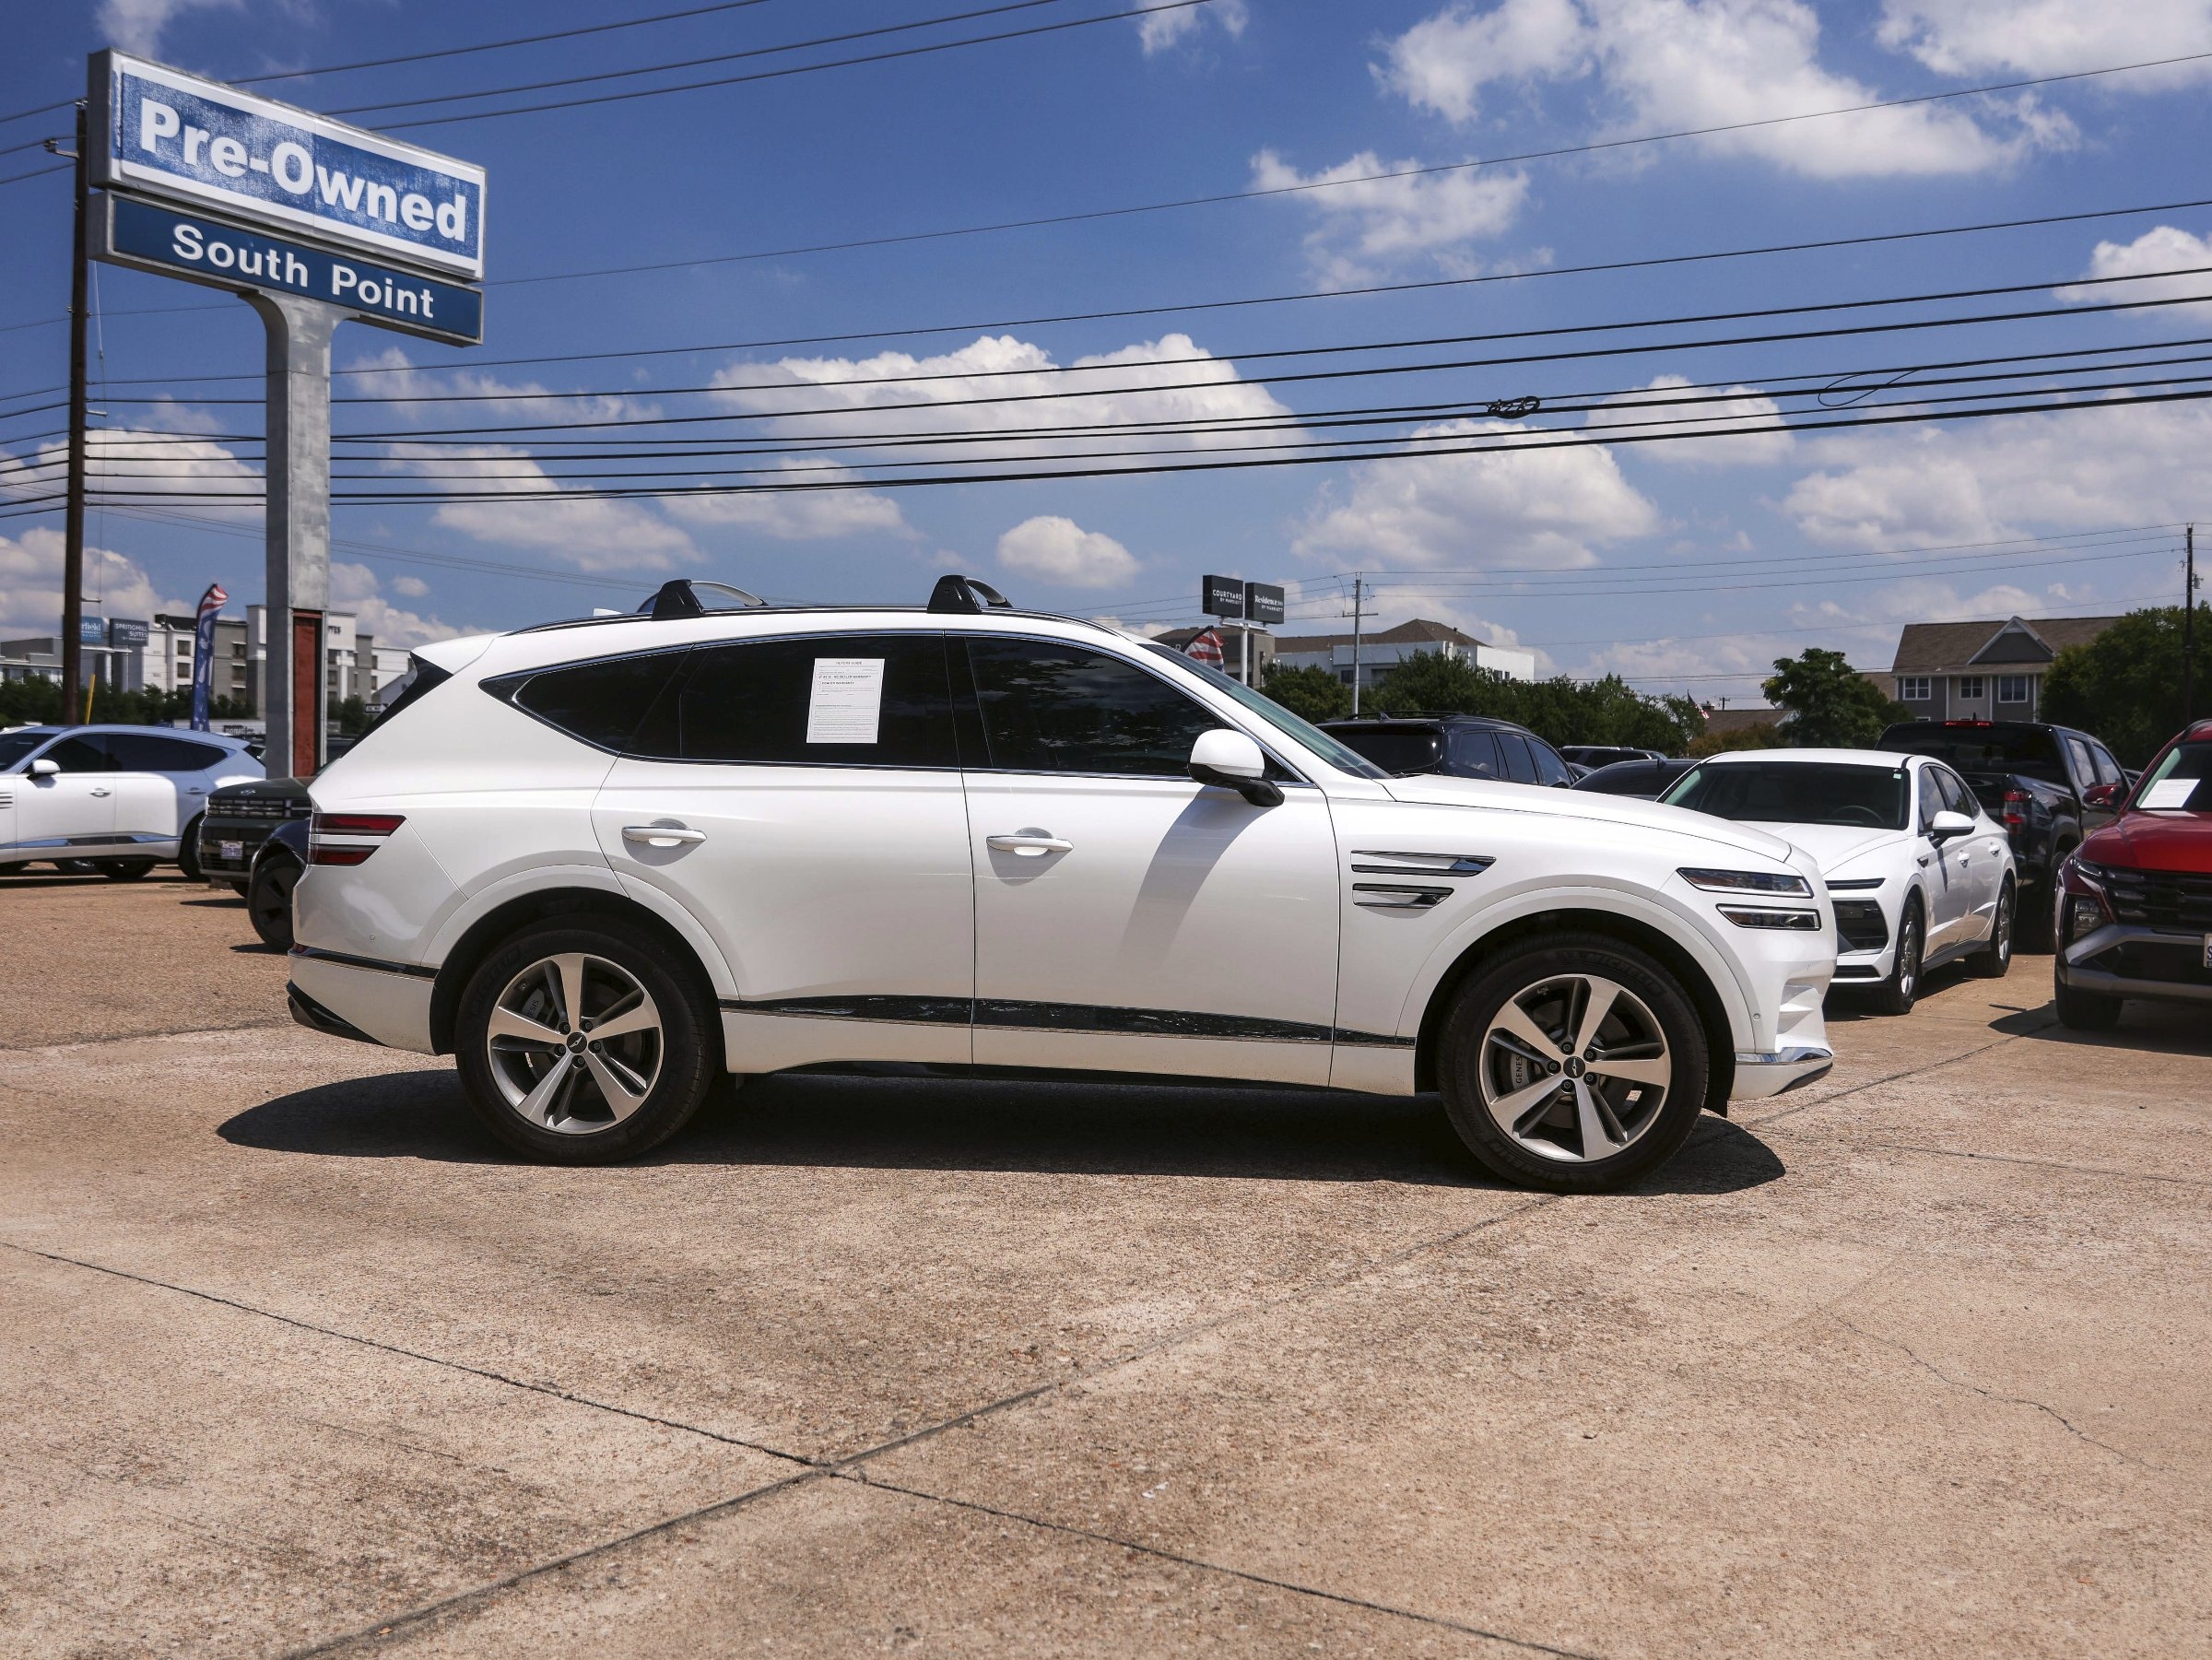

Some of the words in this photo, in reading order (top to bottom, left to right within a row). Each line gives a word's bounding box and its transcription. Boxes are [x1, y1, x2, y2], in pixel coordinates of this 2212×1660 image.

[139, 98, 466, 242] Pre-Owned
[172, 224, 308, 288] South
[332, 264, 434, 318] Point
[1212, 589, 1242, 601] COURTYARD
[1254, 595, 1277, 606] Residence
